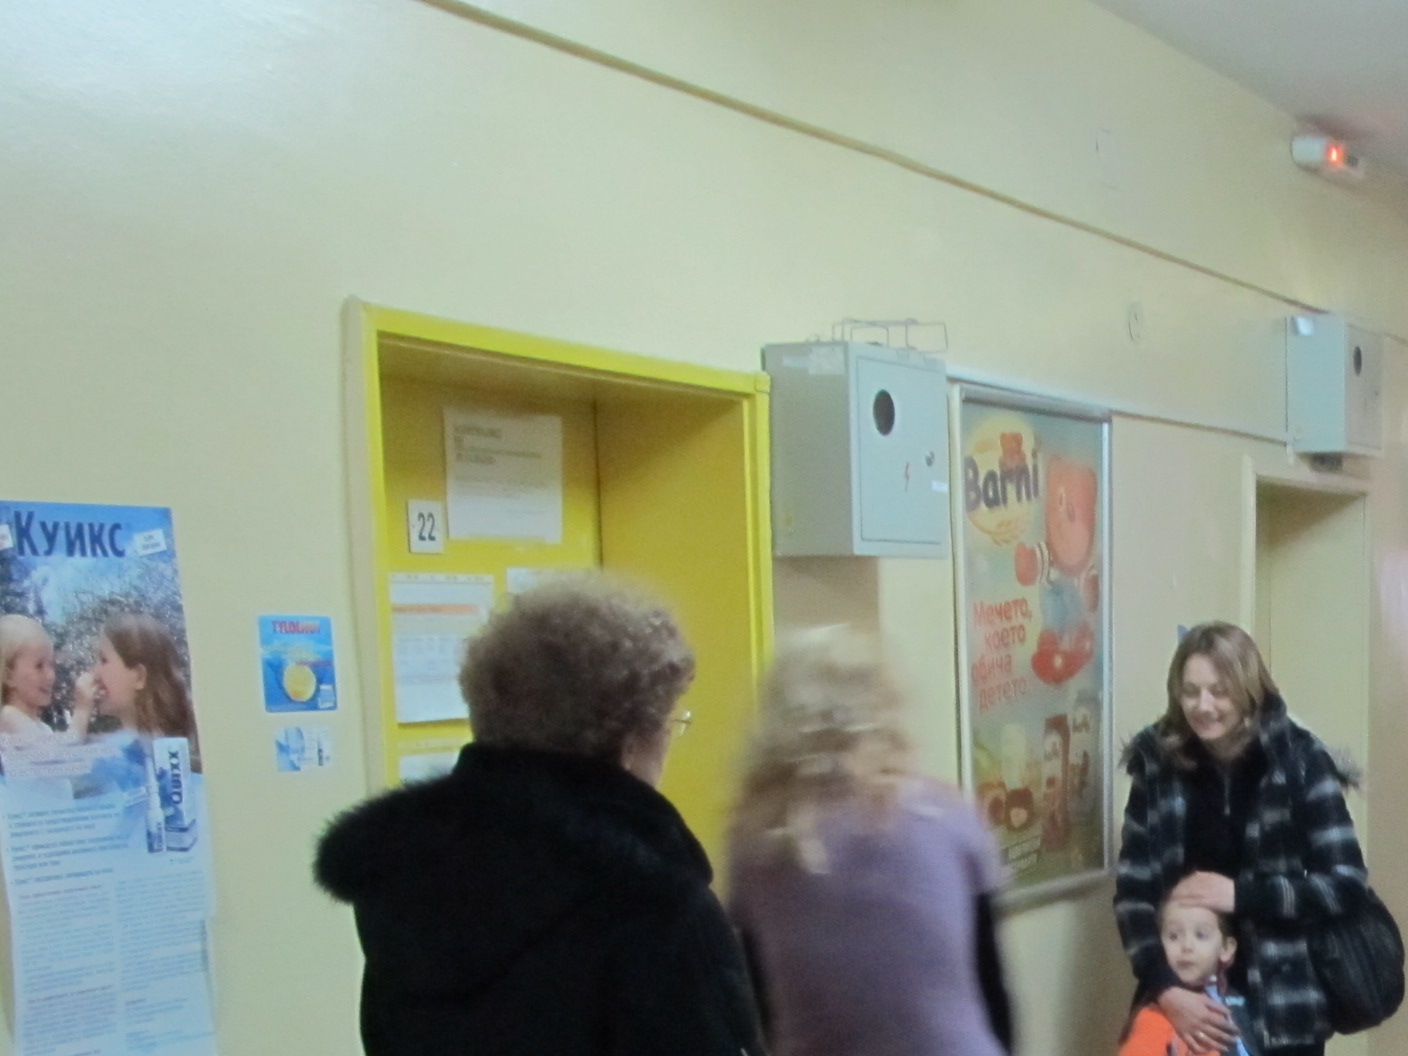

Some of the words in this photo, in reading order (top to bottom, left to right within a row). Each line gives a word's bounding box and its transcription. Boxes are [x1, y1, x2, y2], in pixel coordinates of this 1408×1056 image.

[963, 446, 1040, 513] Barni
[417, 512, 436, 541] 22
[984, 624, 1026, 651] което
[979, 677, 1027, 712] детето
